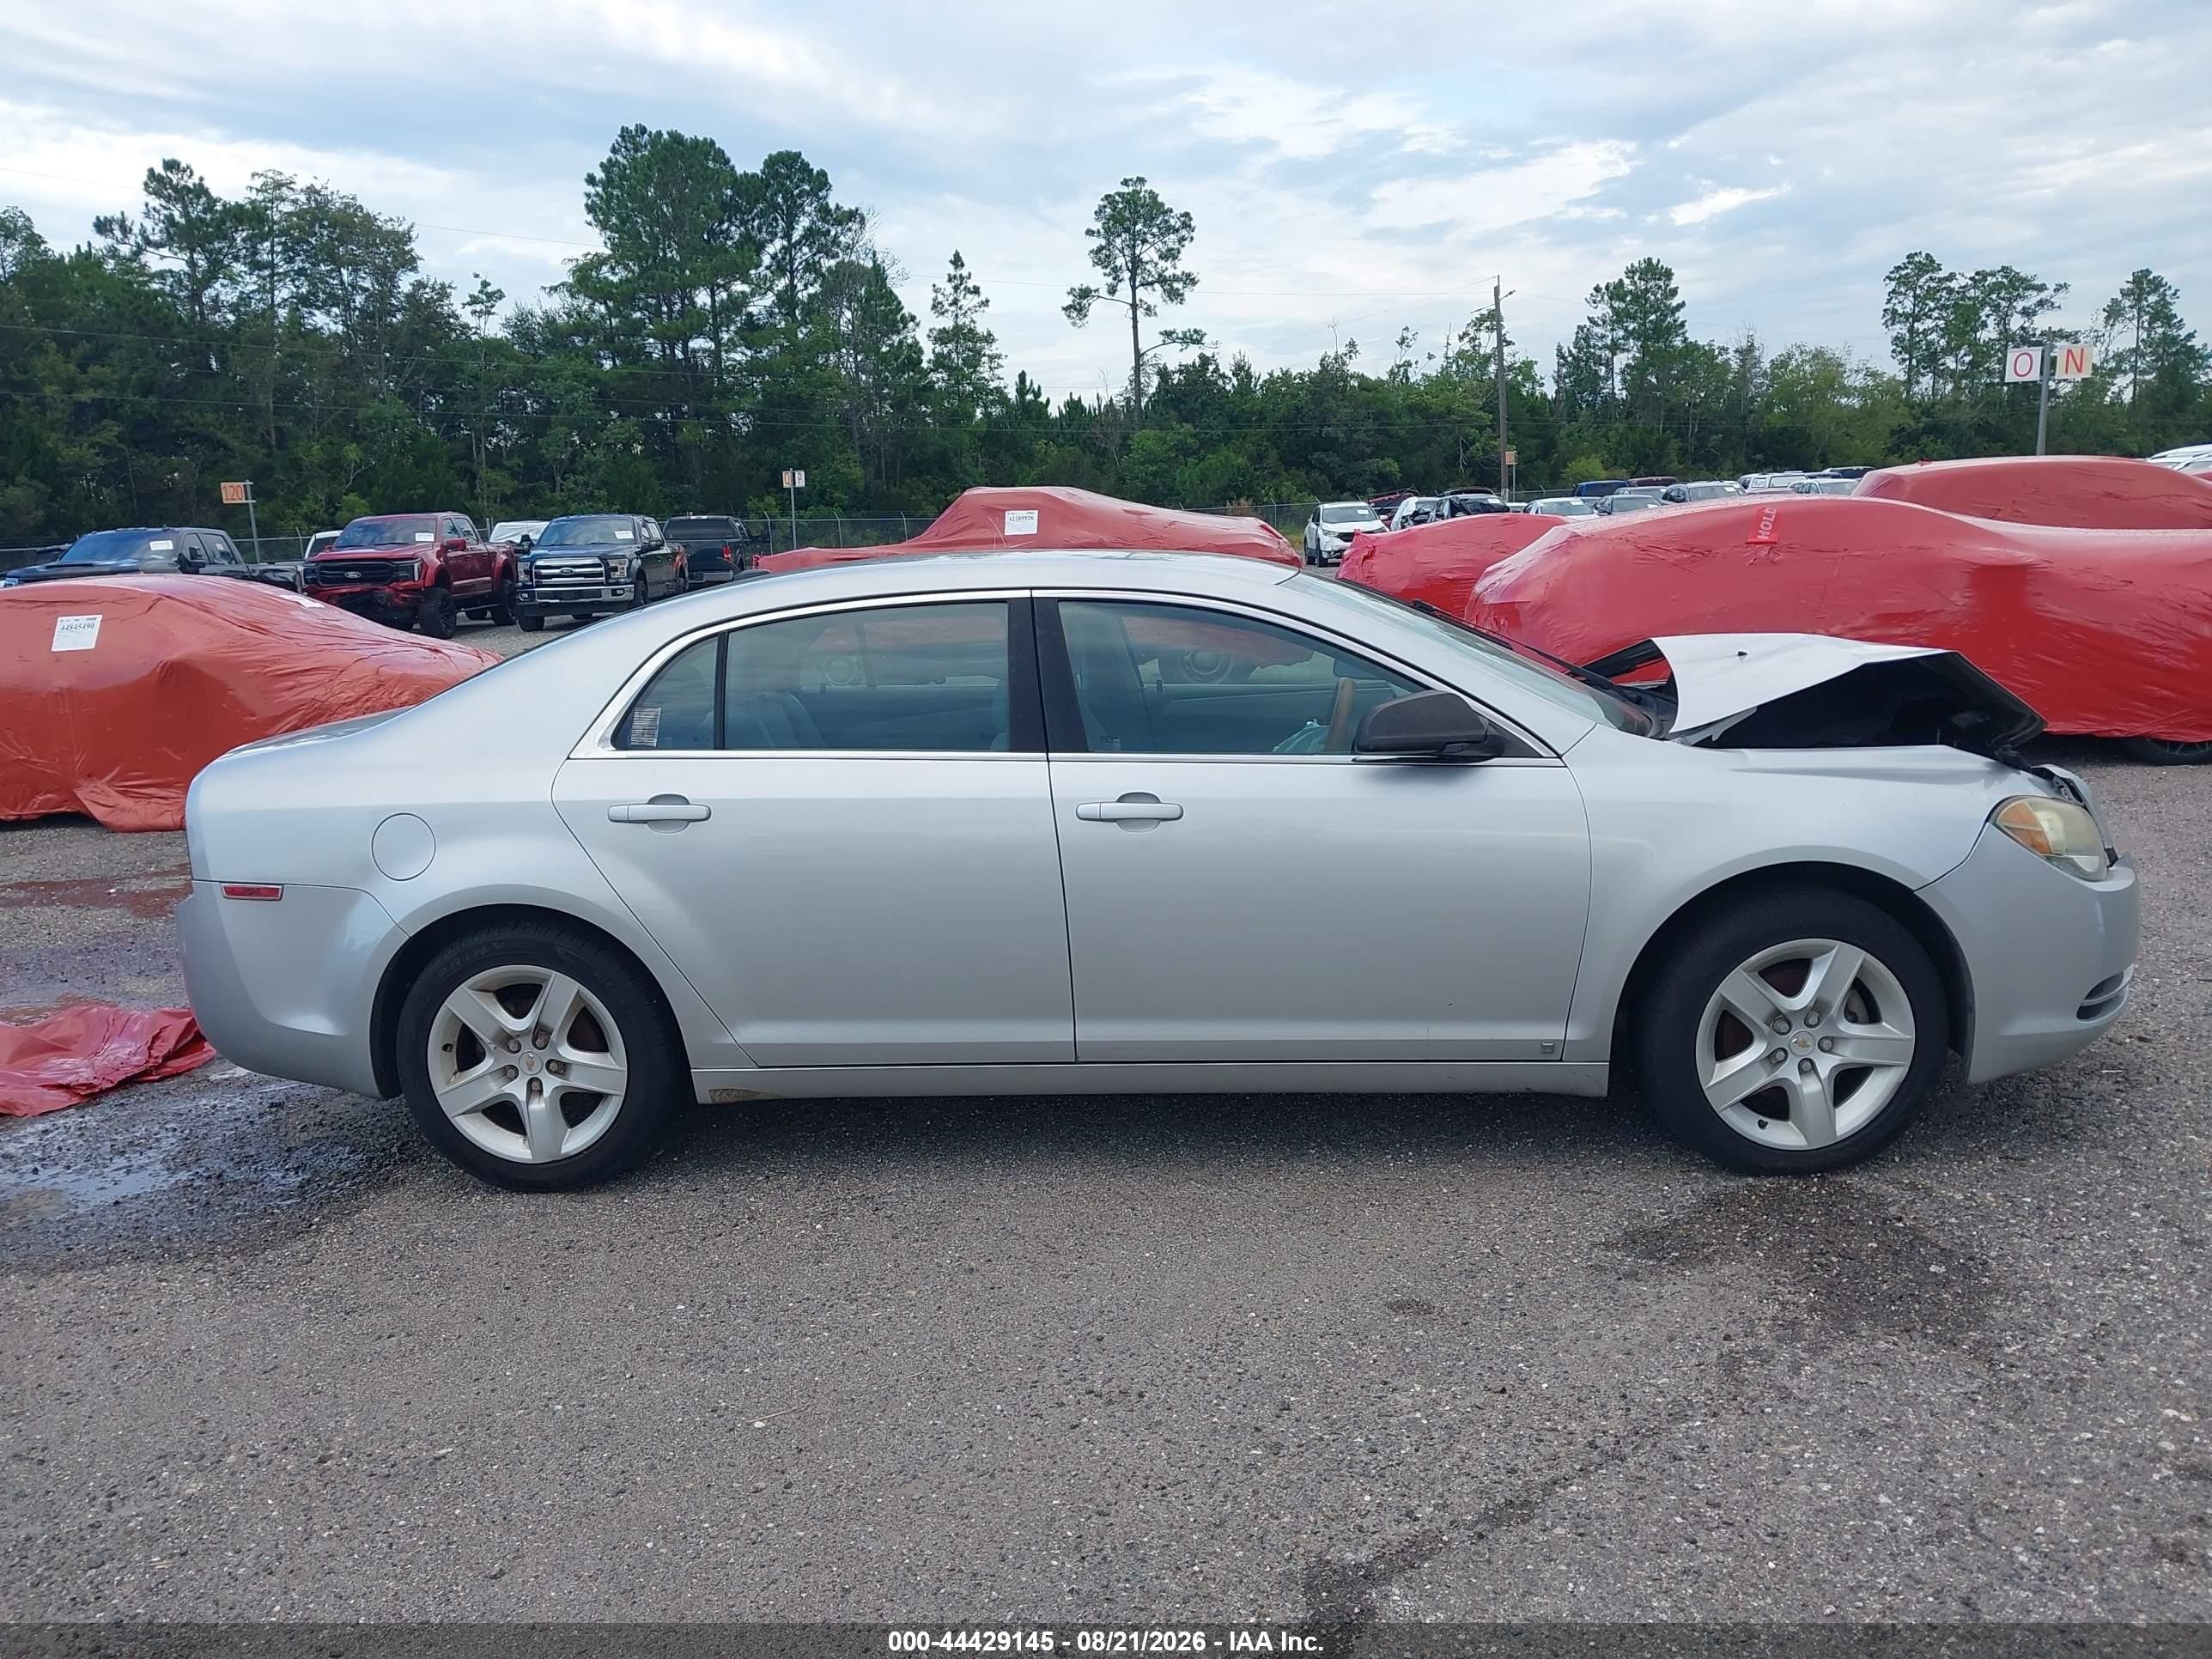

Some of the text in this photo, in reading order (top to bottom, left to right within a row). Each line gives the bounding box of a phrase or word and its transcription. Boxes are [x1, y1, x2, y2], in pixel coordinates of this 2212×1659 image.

[2013, 352, 2033, 377] O
[2064, 348, 2084, 374] N
[797, 472, 803, 485] P
[223, 484, 244, 501] 120
[1757, 507, 1777, 539] HOLD
